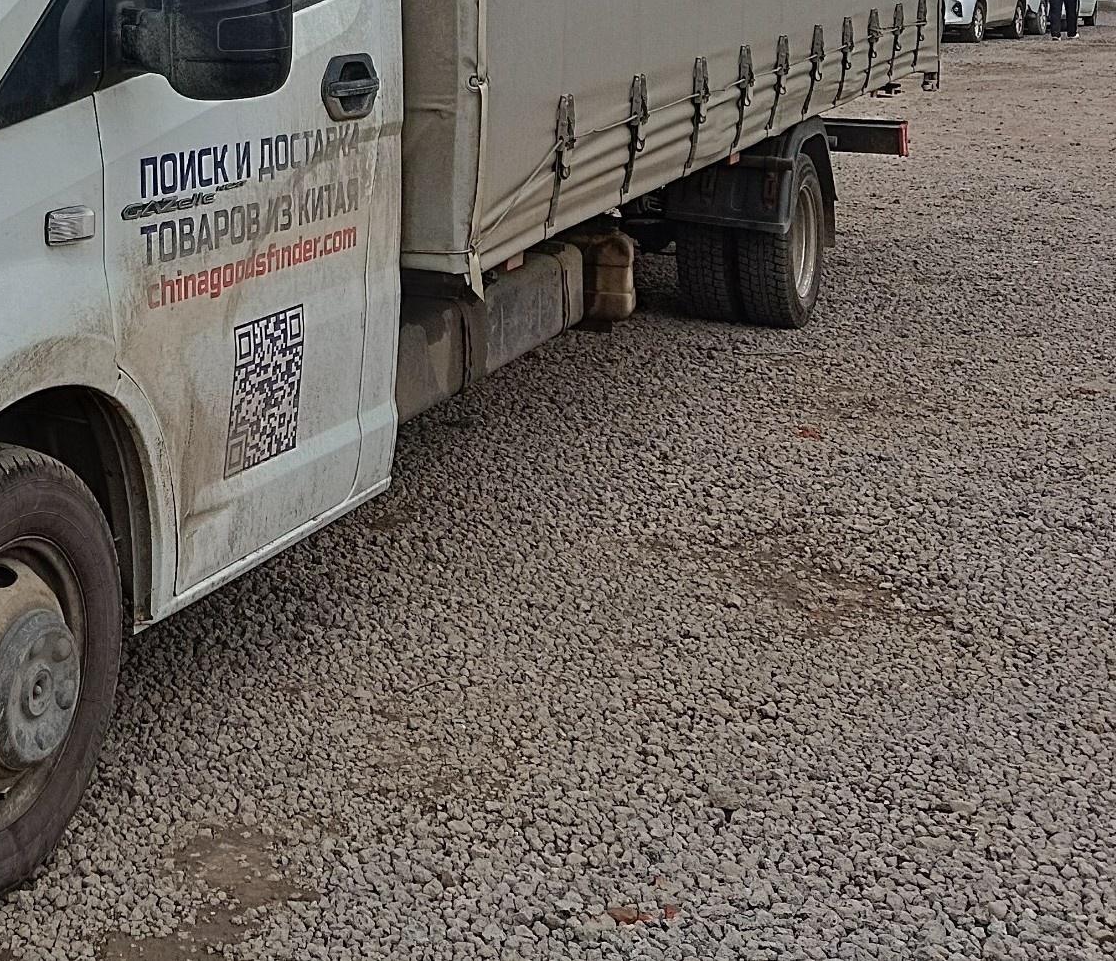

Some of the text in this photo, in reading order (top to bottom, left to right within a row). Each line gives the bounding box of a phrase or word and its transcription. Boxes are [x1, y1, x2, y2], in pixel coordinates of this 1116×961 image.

[140, 122, 361, 199] ПОИСК И ДОСТАВКА
[140, 178, 359, 266] ТОВАРОВ ИЗ КИТАЯ
[146, 224, 358, 309] chinagoodsfinder.com
